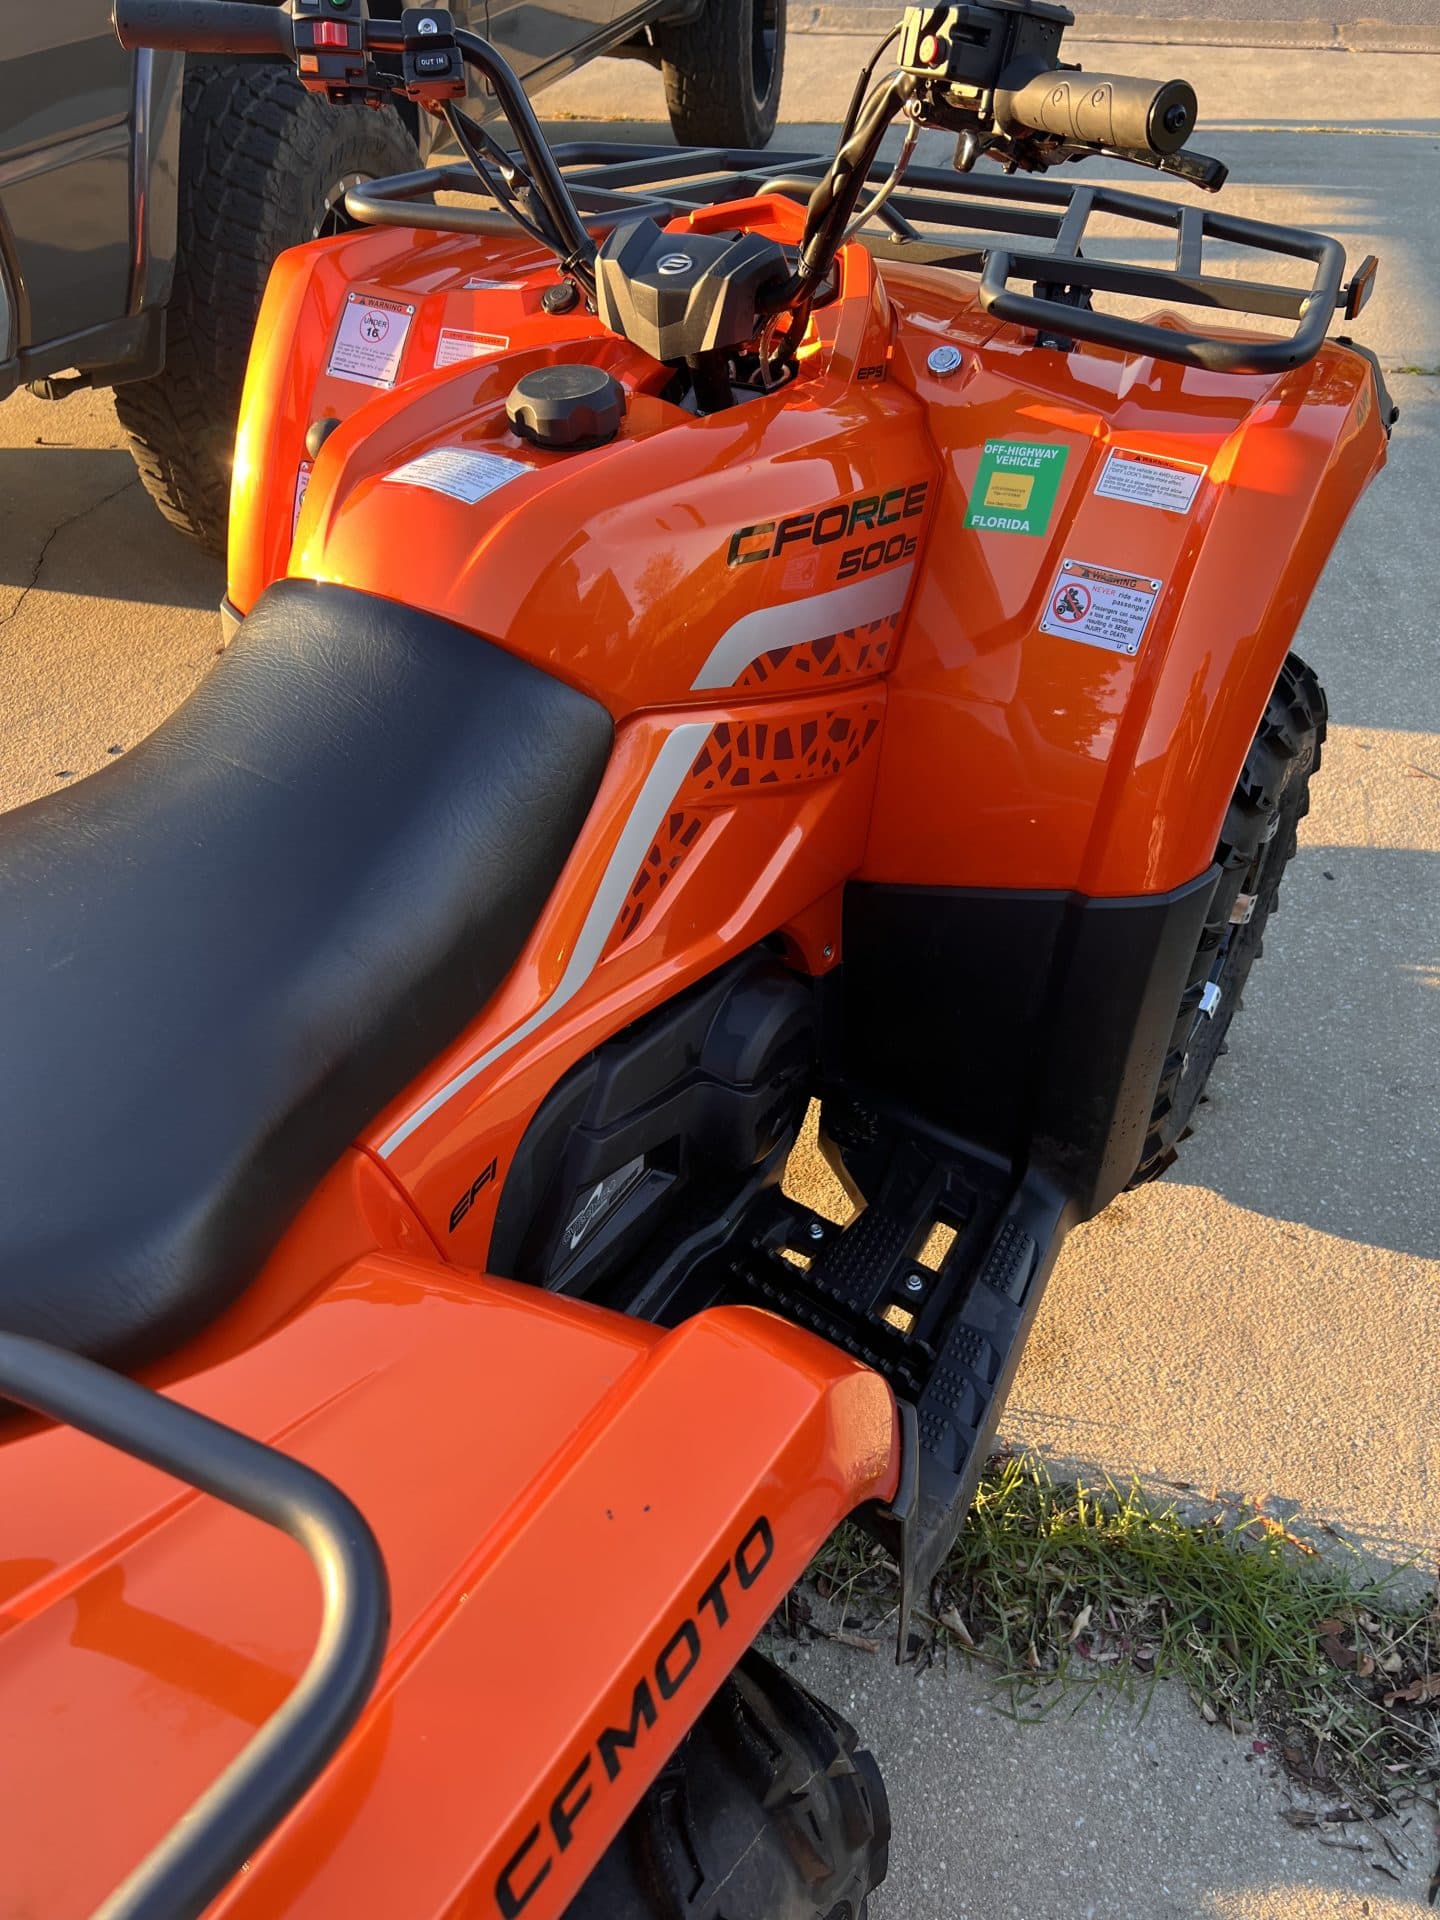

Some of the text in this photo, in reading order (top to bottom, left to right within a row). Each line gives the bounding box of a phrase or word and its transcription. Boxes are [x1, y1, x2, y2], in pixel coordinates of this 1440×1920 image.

[368, 299, 402, 312] WARNING
[363, 317, 387, 328] UNDER
[366, 327, 380, 338] 16
[856, 365, 884, 380] EPS
[984, 444, 1059, 459] OFF-HIGHWAY
[995, 455, 1041, 468] VEHICLE
[727, 481, 928, 568] CFORCE
[971, 515, 1030, 531] FLORIDA
[1092, 571, 1137, 588] WARNING
[1092, 586, 1116, 597] NEVER
[1118, 592, 1132, 600] ride
[1091, 604, 1118, 615] Passengers
[1129, 613, 1144, 621] cause
[1084, 624, 1102, 634] INJURY
[1087, 618, 1107, 628] resulting
[1113, 623, 1135, 634] SEVERE
[448, 1155, 498, 1234] EFI
[494, 1515, 775, 1920] CFMOTO
